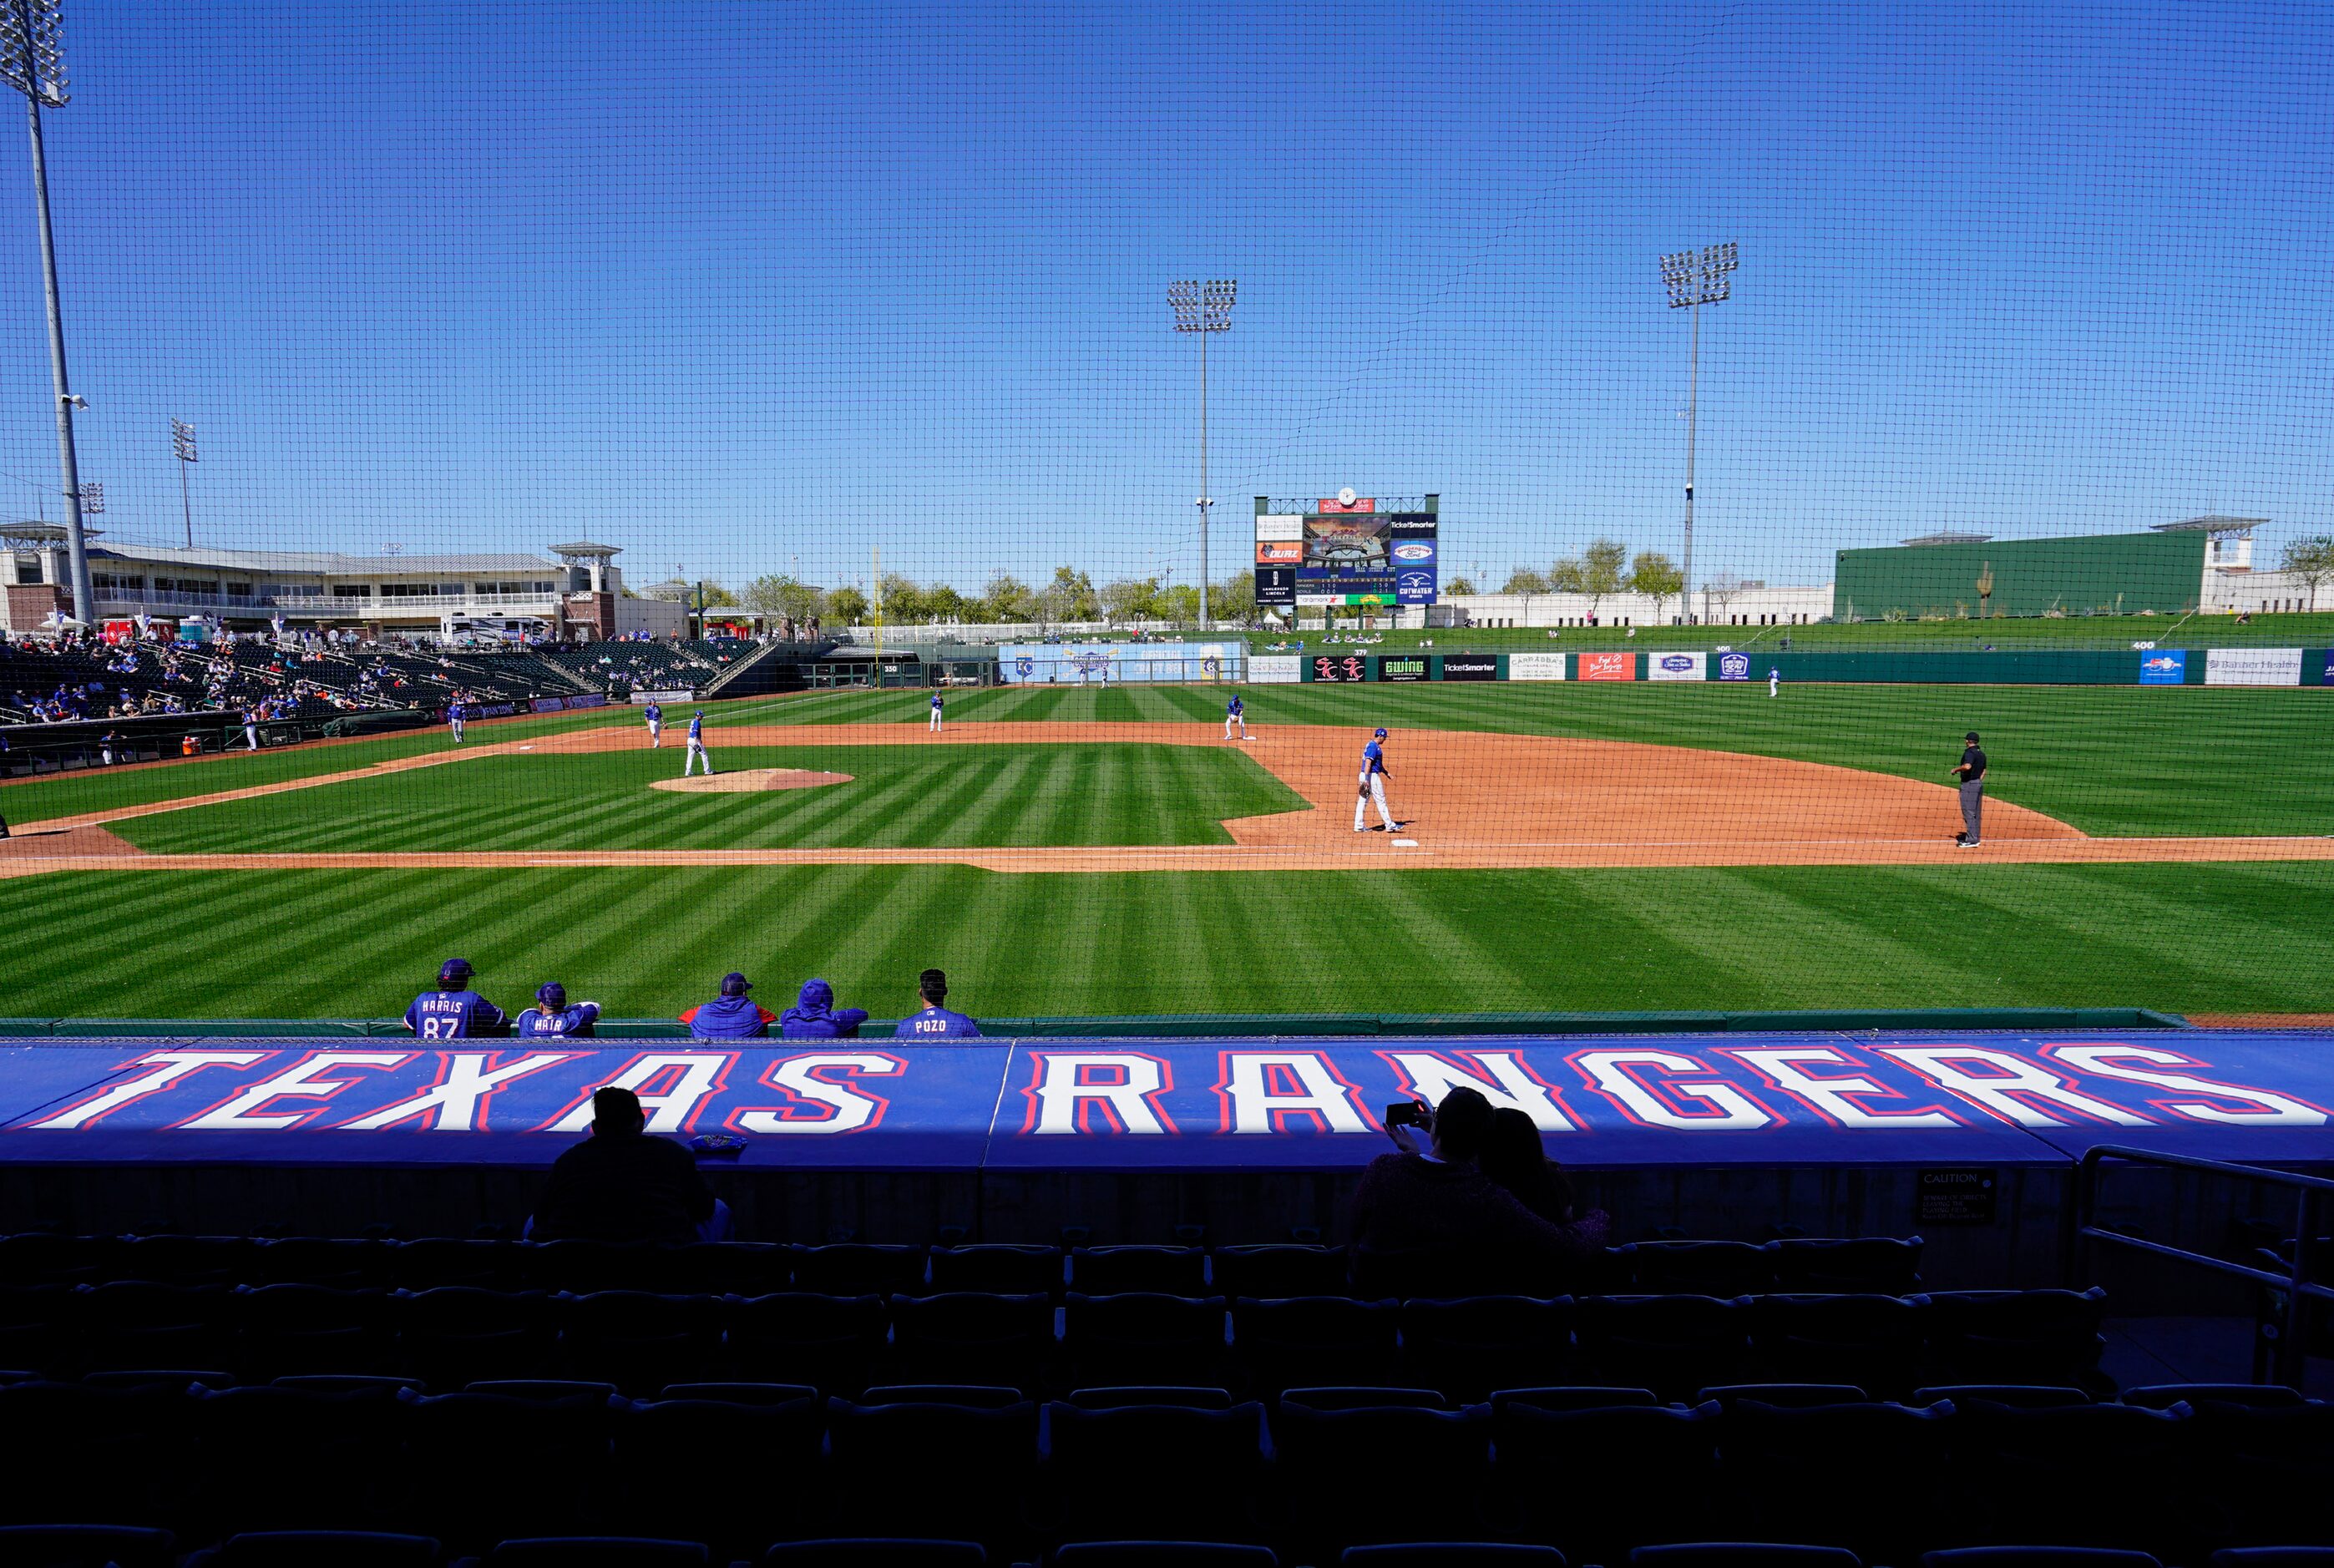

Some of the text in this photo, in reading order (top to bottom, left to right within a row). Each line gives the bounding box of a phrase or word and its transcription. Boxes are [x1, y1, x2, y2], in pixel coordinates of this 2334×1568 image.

[2261, 660, 2296, 669] Health
[423, 1000, 463, 1014] HARRIS
[423, 1017, 458, 1038] 87
[534, 1019, 562, 1031] HAIR
[915, 1019, 946, 1033] POZO
[28, 1049, 2330, 1131] TEXAS RANGERS
[1924, 1174, 1977, 1183] CAUTION
